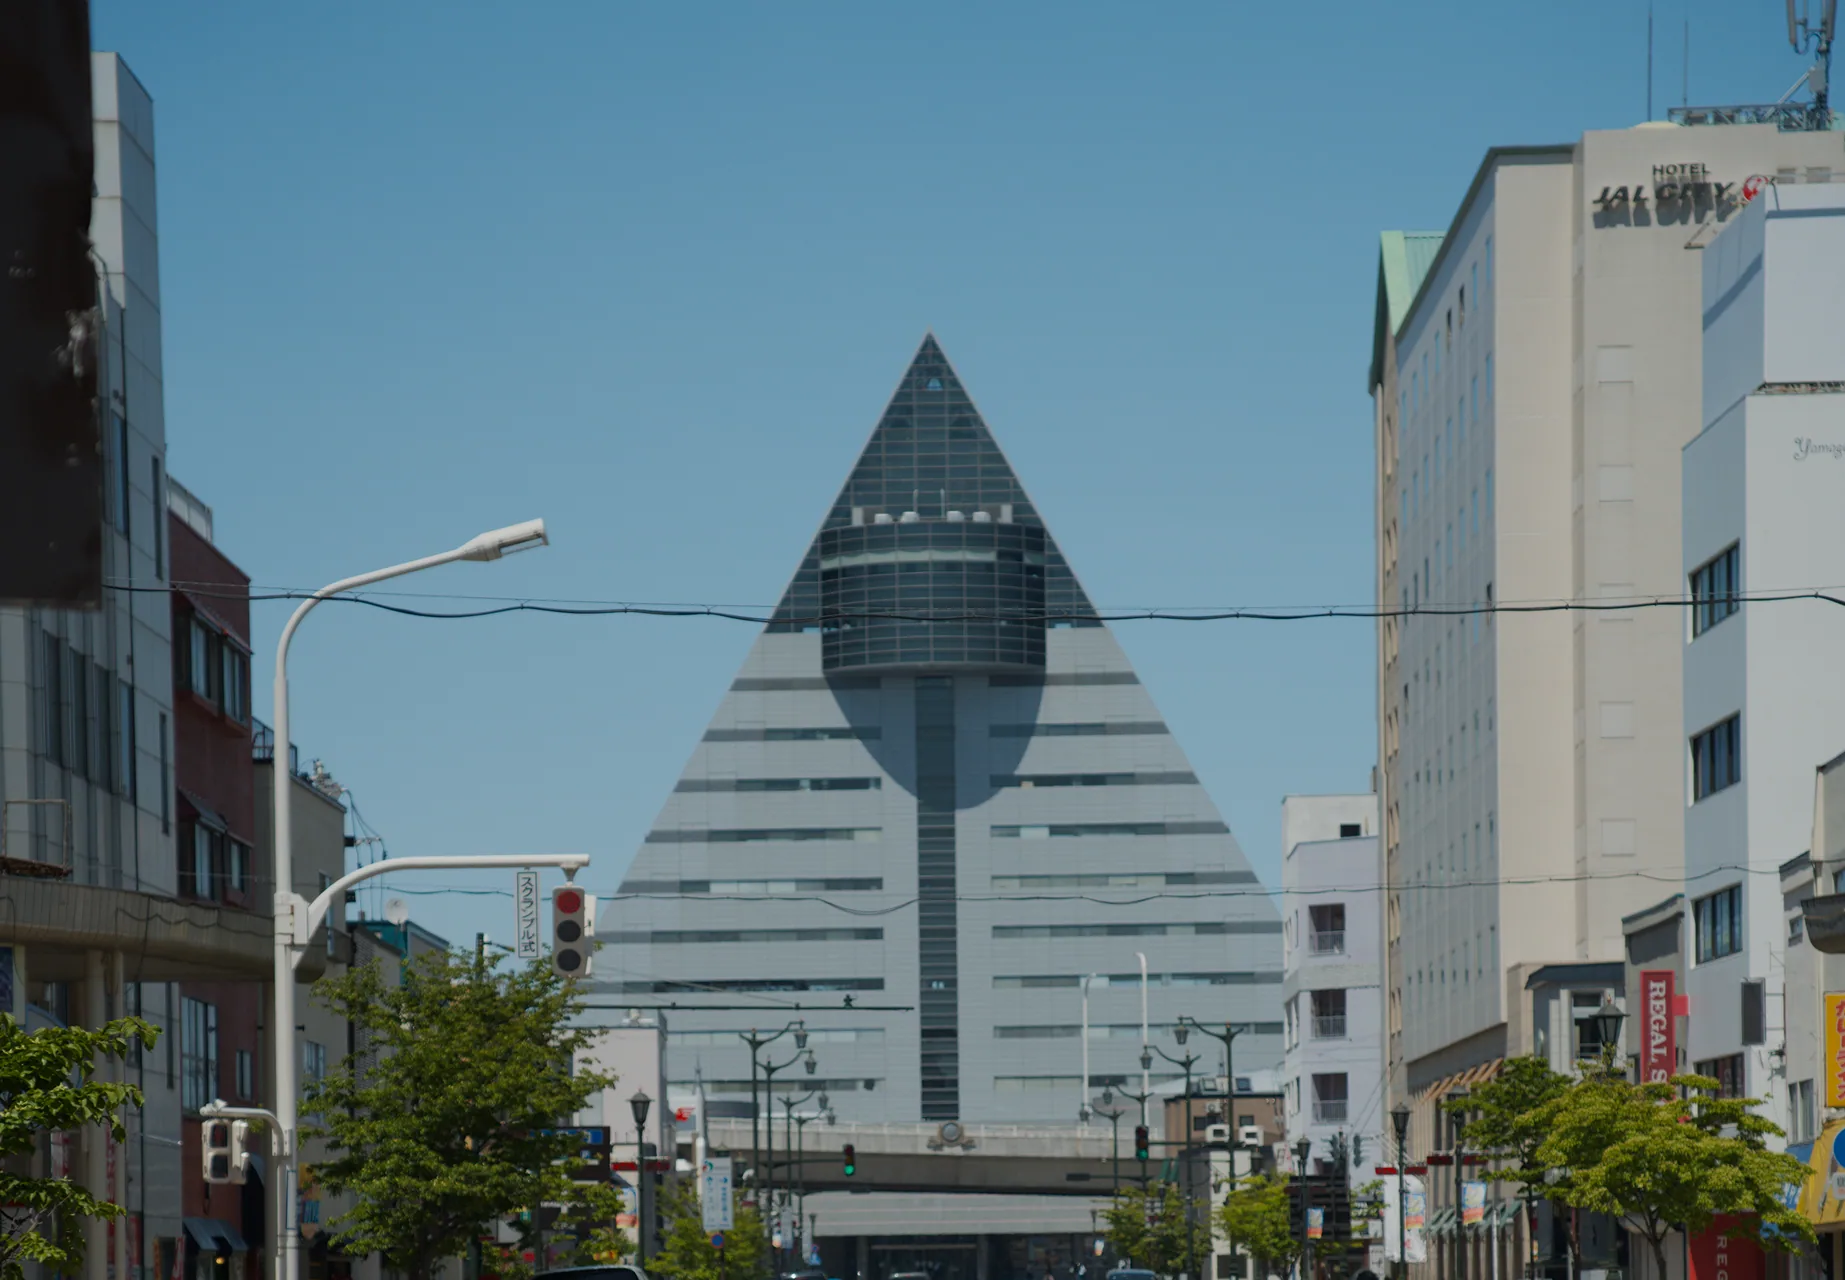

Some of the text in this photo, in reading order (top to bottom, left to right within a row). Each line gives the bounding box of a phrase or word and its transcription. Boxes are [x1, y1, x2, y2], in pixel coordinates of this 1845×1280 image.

[1653, 163, 1710, 176] HOTEL
[1593, 182, 1735, 204] JAL CITY
[1649, 980, 1667, 1063] REGAL
